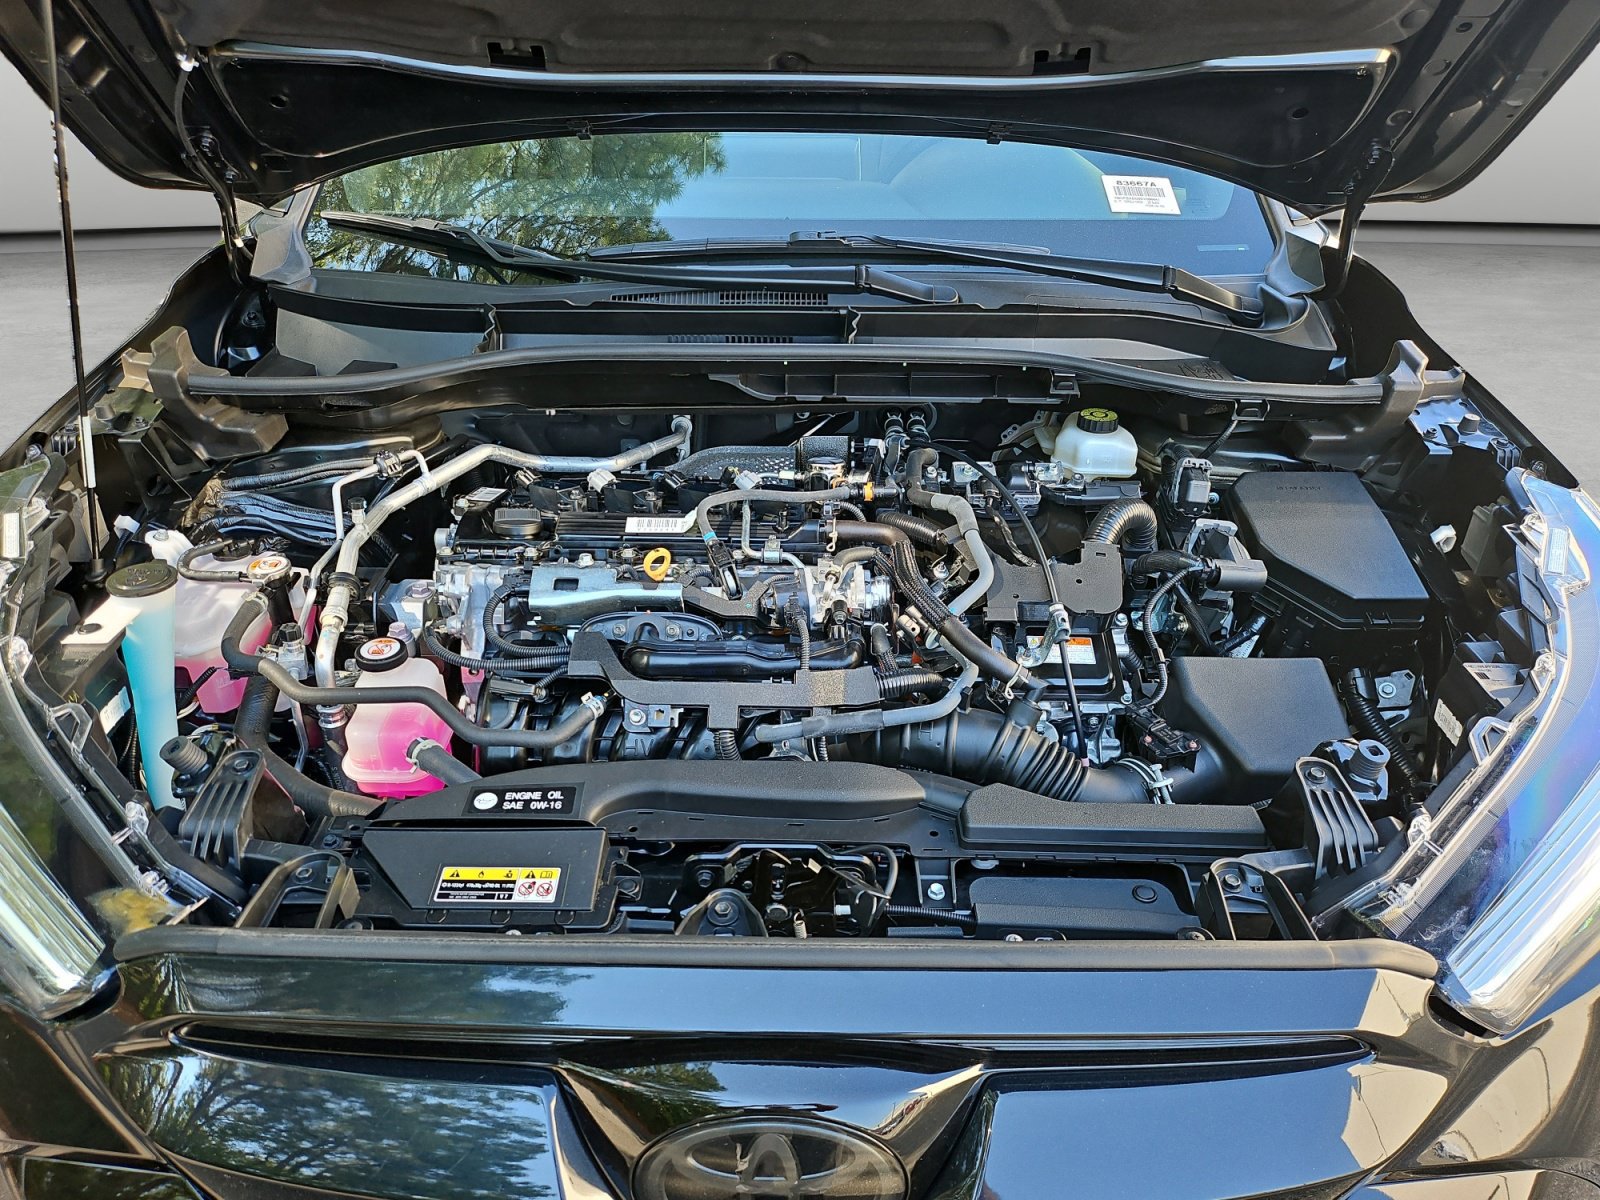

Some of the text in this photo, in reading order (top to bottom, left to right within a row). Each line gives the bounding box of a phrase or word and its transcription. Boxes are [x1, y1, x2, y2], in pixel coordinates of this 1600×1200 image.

[504, 791, 564, 800] ENGINE OIL
[502, 801, 562, 810] SAE 0W-16
